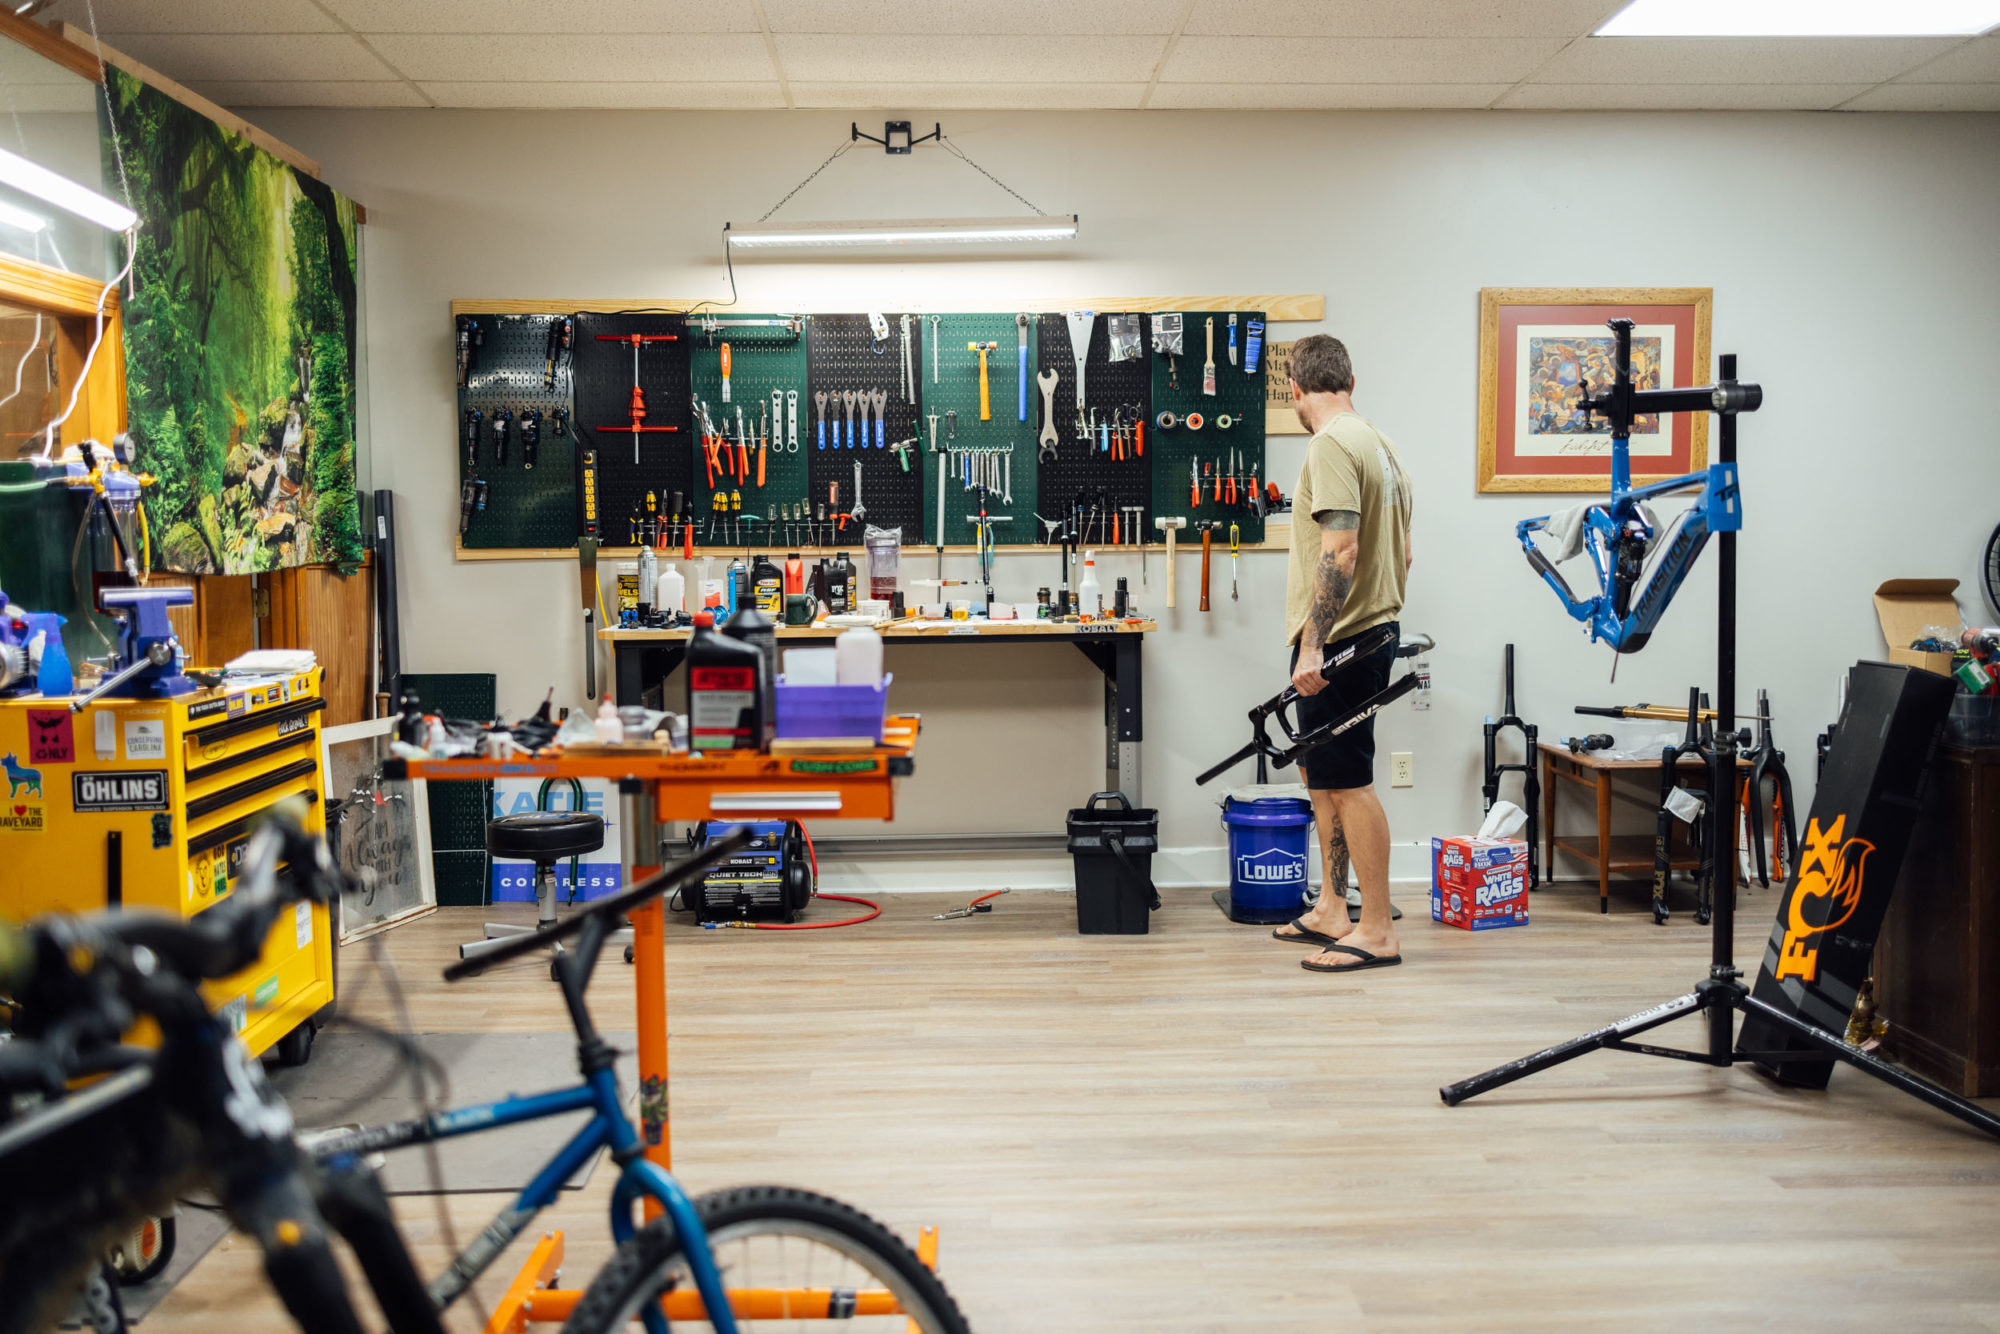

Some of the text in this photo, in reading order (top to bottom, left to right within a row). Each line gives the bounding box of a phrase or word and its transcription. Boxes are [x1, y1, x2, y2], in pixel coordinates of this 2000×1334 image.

[1631, 529, 1692, 622] TRANSITION
[1075, 624, 1117, 633] KOBALT
[82, 777, 158, 801] ÖHLINS
[709, 871, 737, 879] QUIET
[1244, 861, 1303, 880] LOWE'S
[1482, 871, 1512, 886] WHITE
[501, 877, 615, 887] CORESS
[1475, 876, 1524, 907] RAGS
[1775, 813, 1858, 982] FOX
